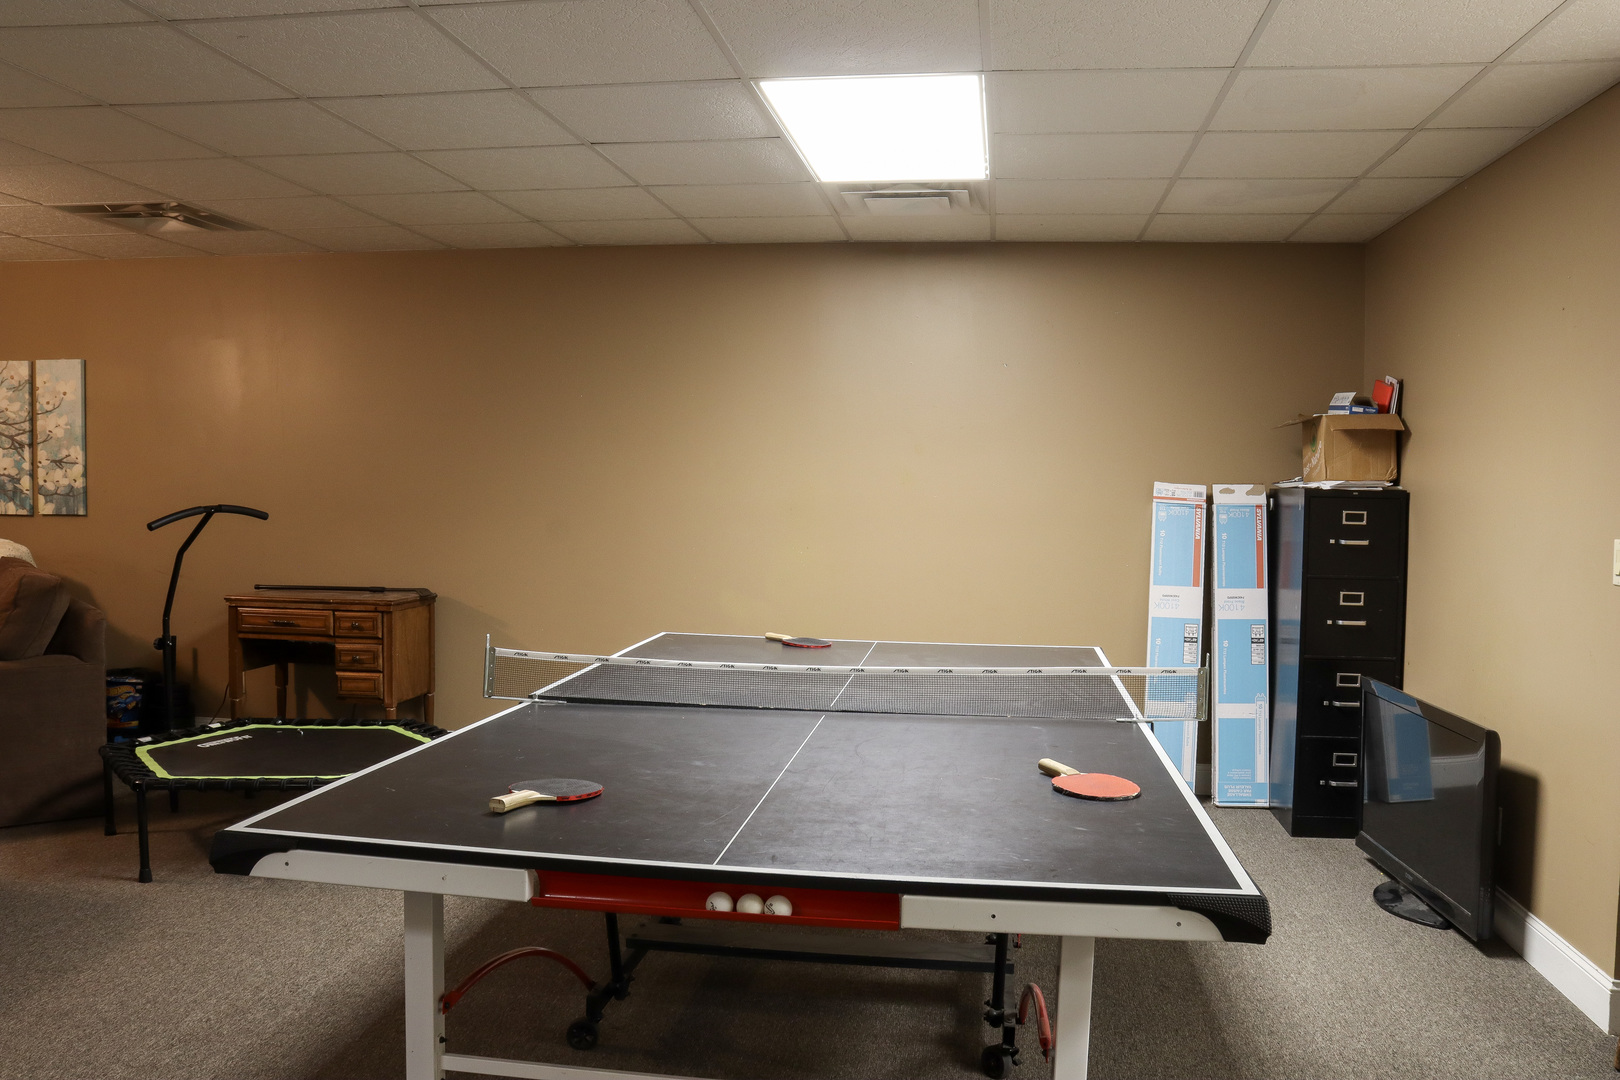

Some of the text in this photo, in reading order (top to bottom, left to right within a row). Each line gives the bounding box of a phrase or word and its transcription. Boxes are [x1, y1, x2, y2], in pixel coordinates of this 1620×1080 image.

[1153, 601, 1180, 609] 4100K
[1218, 603, 1245, 611] 4100K
[1155, 637, 1161, 645] 10
